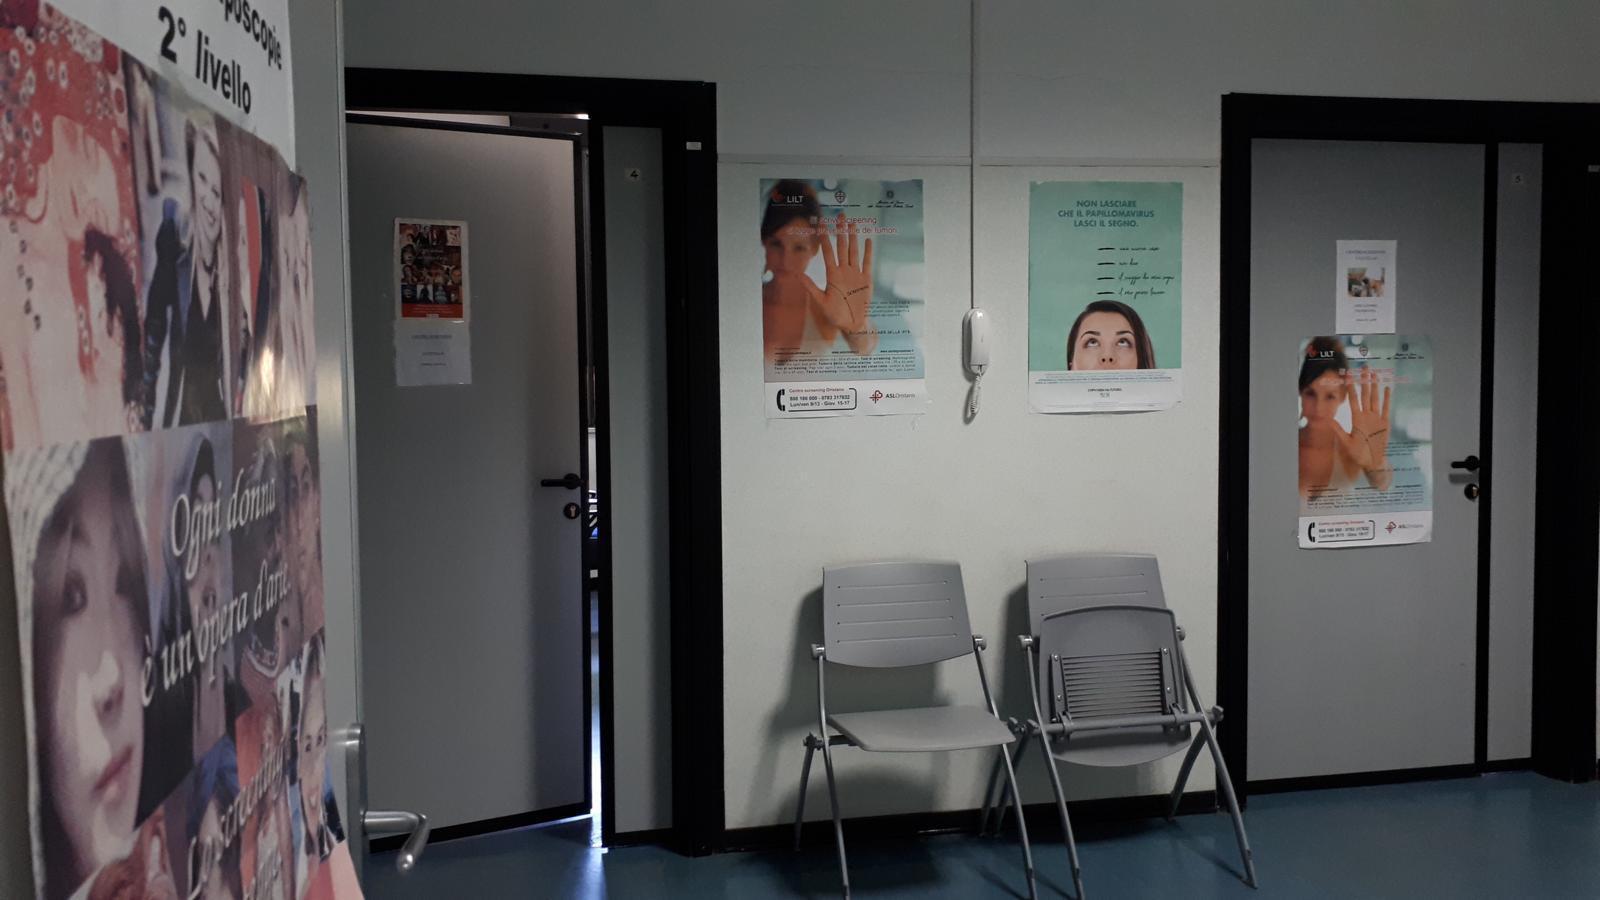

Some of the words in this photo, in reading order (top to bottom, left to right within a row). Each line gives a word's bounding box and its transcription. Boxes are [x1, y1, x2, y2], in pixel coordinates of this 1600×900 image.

[195, 29, 251, 115] livello
[787, 195, 804, 203] LILT
[1076, 200, 1097, 208] NON
[1100, 200, 1137, 208] LASCIARE
[1057, 210, 1074, 218] CHE
[1076, 210, 1084, 218] IL
[1086, 210, 1155, 218] PAPILLOMAVIRUS
[1073, 220, 1097, 228] LASCI
[1099, 220, 1106, 228] IL
[1107, 220, 1139, 228] SEGNO.
[1319, 350, 1335, 358] LILT
[170, 480, 221, 581] Ogni
[225, 466, 276, 532] donna
